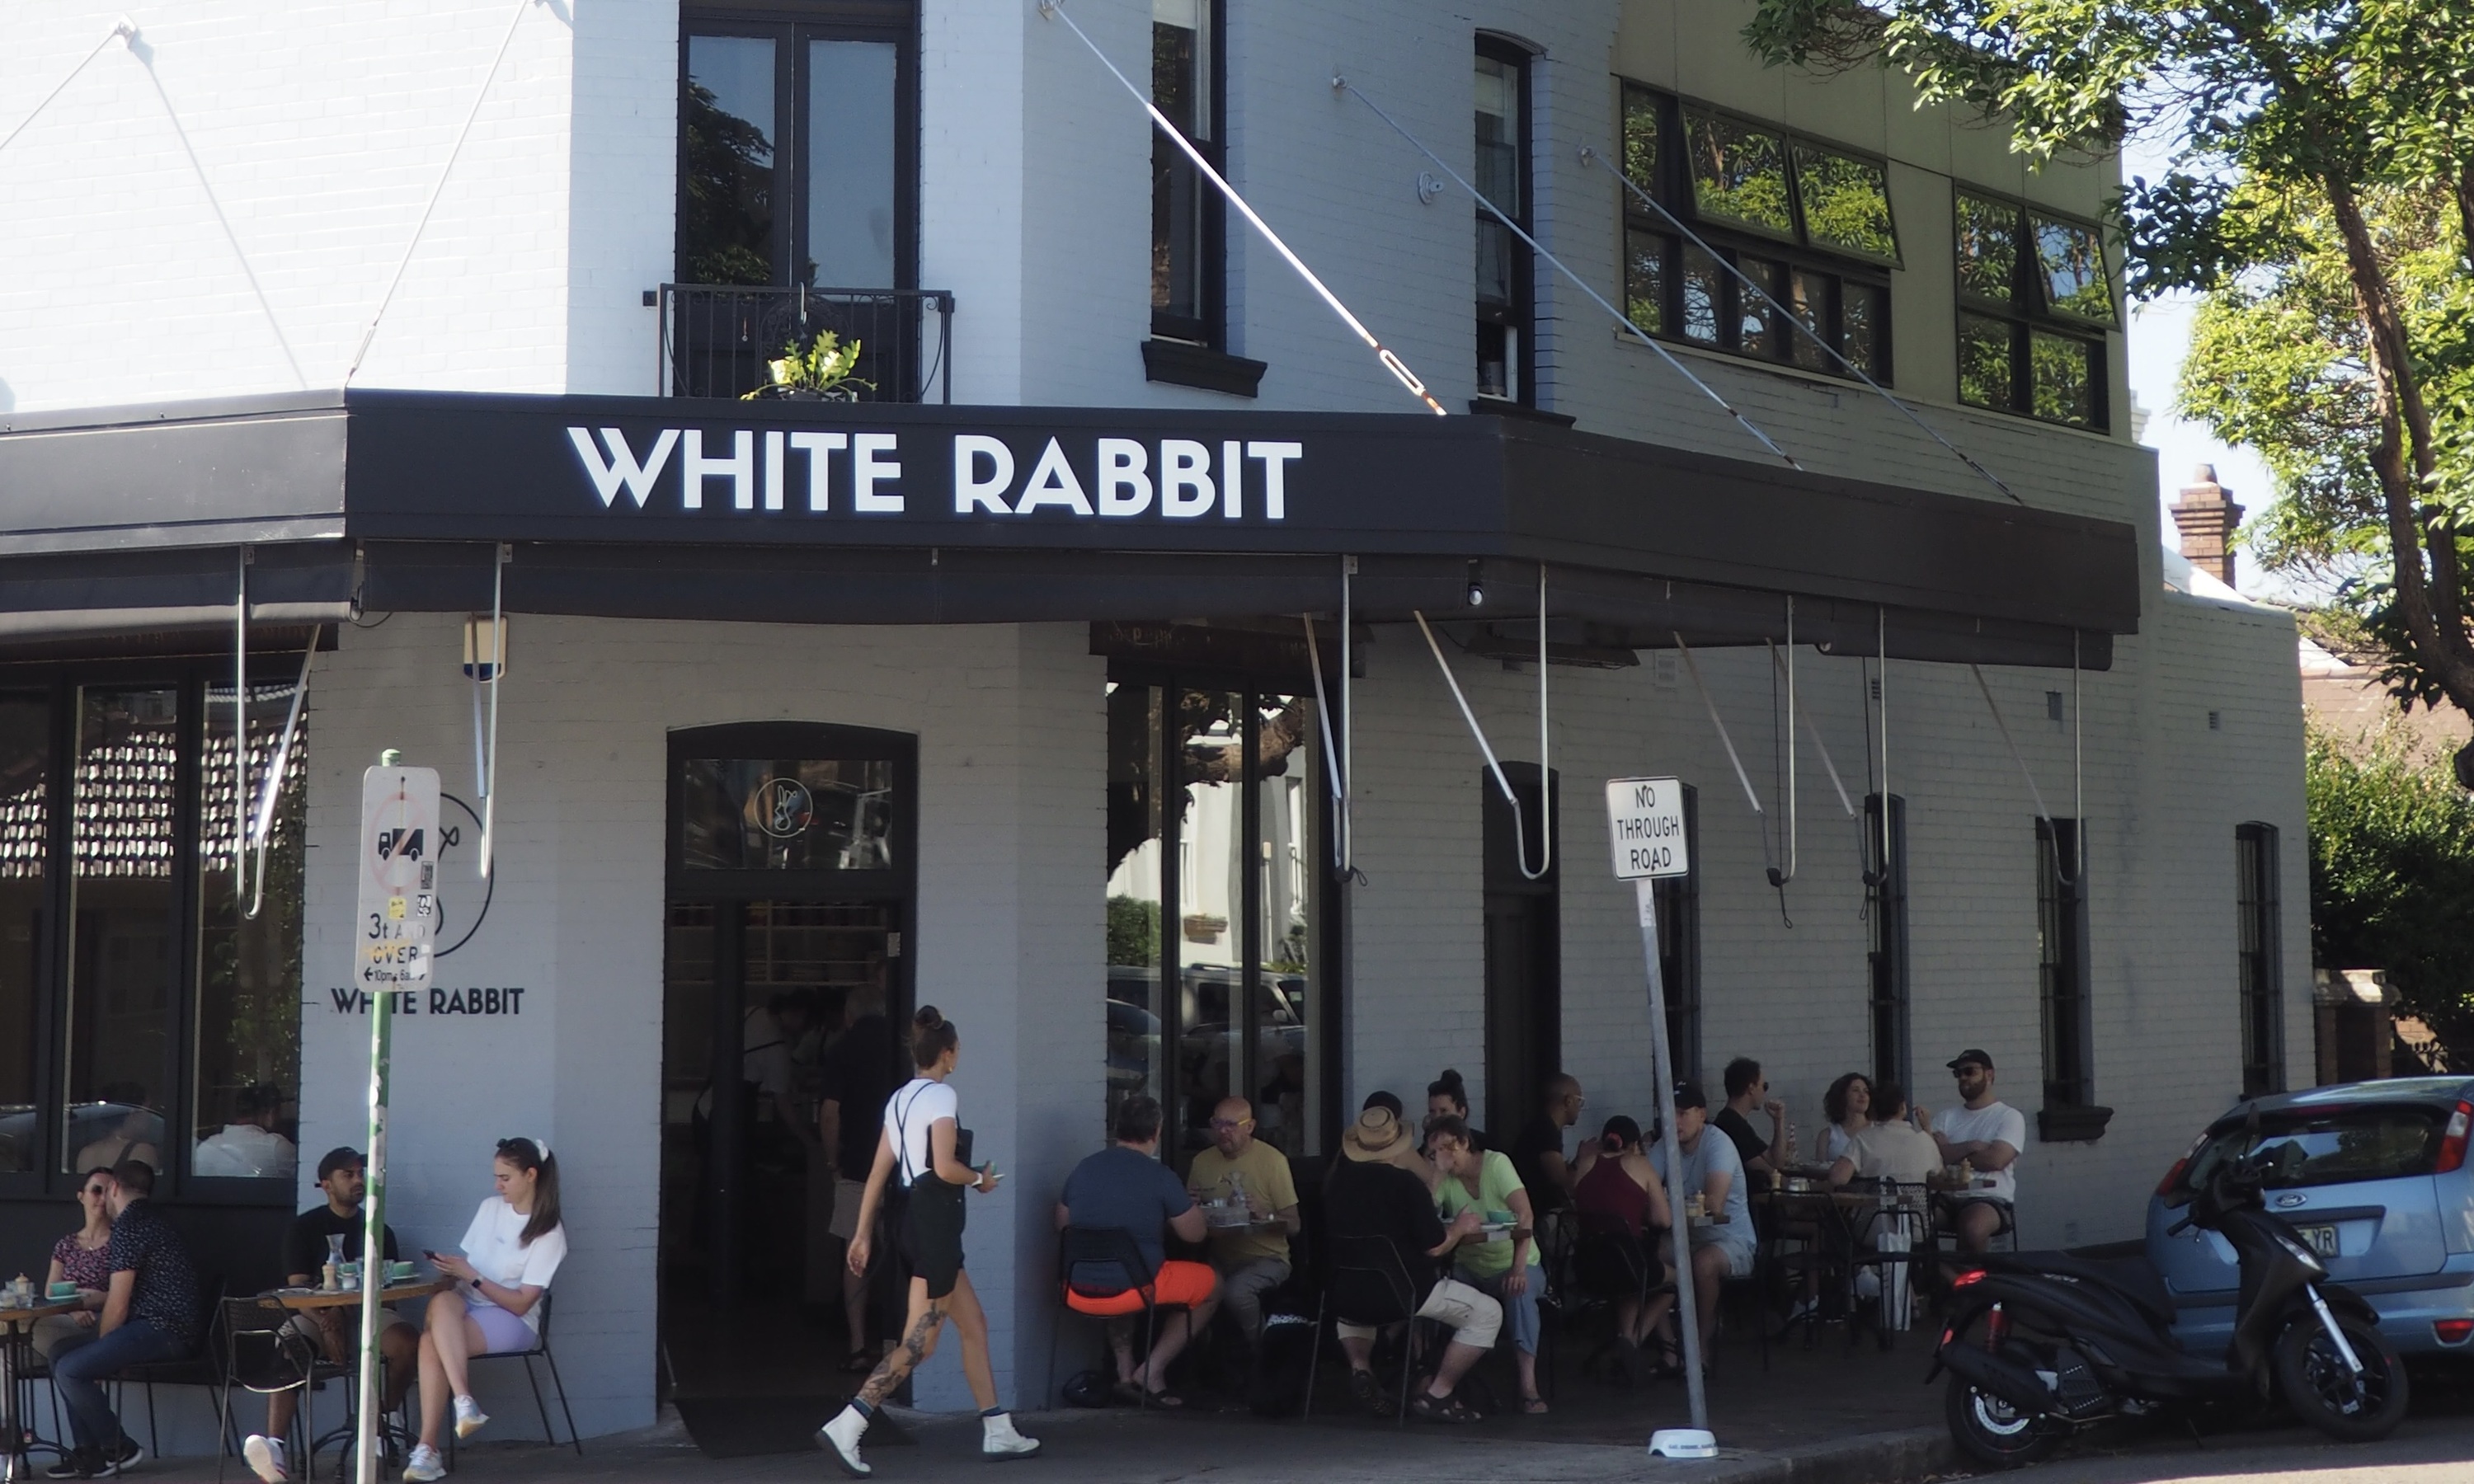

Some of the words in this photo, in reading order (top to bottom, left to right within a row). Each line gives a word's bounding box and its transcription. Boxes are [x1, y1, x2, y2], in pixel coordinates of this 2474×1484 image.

[567, 426, 905, 513] WHITE
[955, 434, 1304, 519] RABBIT
[1635, 787, 1655, 808] NO
[1617, 815, 1680, 840] THROUGH
[1630, 847, 1672, 870] ROAD
[369, 913, 388, 939] 3t
[394, 924, 426, 939] AD
[373, 946, 418, 964] OVER
[400, 970, 415, 981] 6a
[331, 988, 417, 1014] WHTE
[430, 988, 525, 1015] RABBIT
[2301, 1229, 2334, 1250] YR
